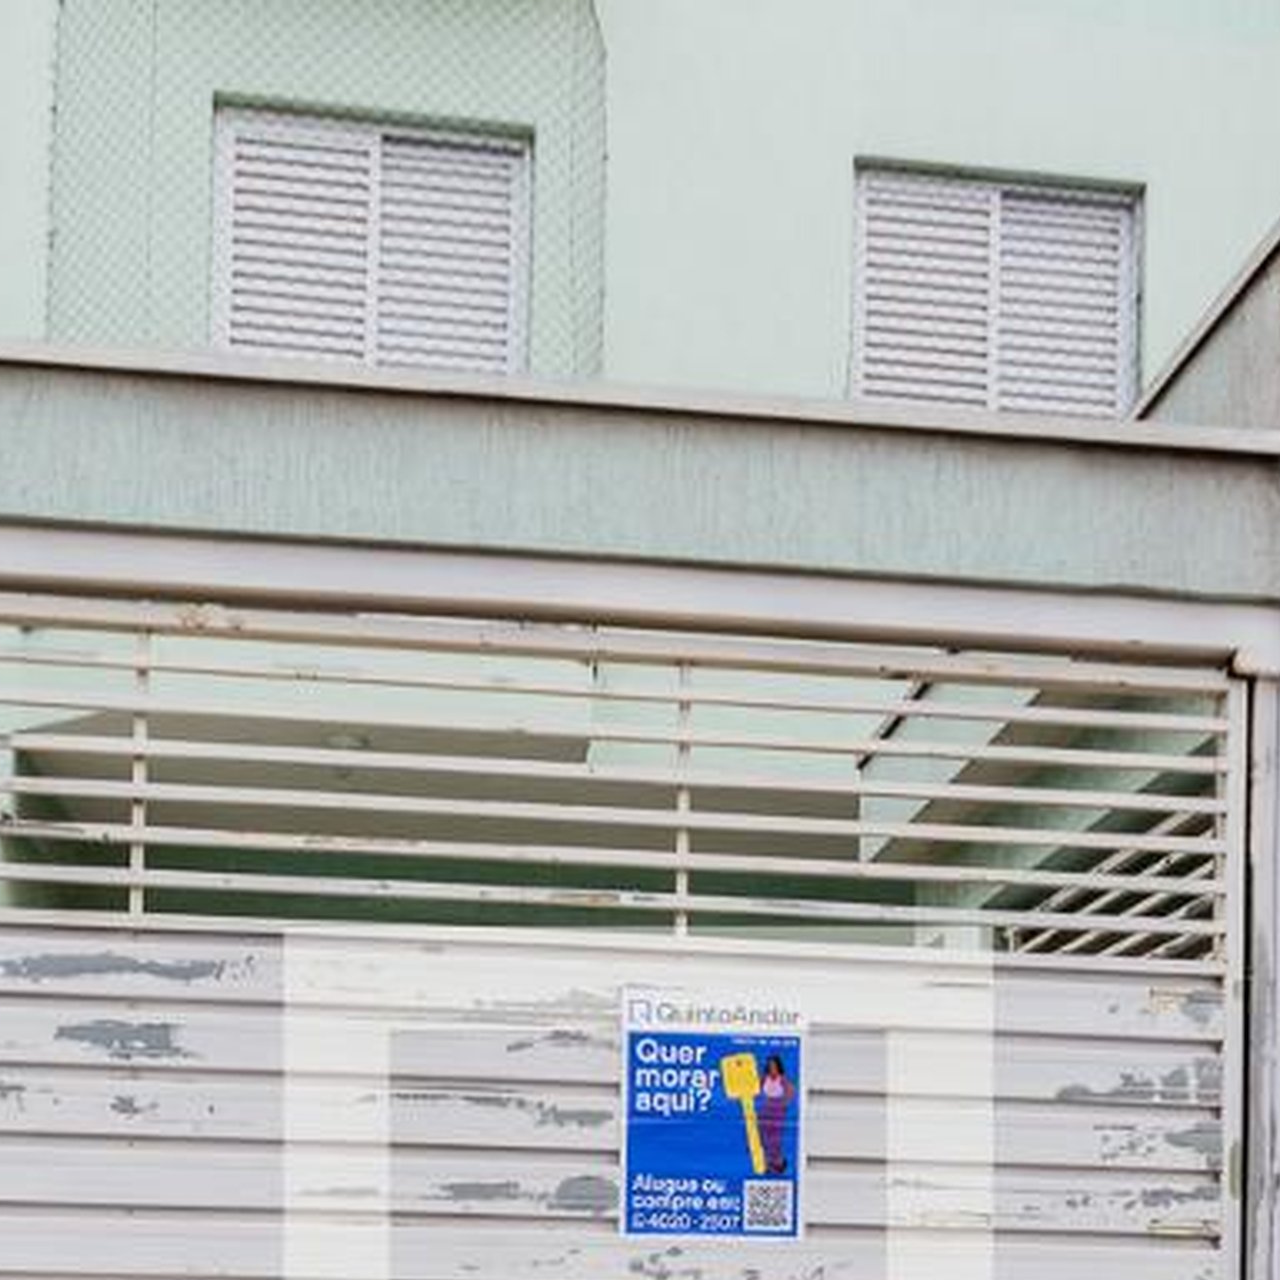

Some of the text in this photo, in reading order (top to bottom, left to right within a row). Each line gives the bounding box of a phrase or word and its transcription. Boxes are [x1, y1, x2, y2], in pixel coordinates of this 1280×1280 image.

[635, 1038, 708, 1063] Quer
[635, 1067, 719, 1089] morar
[635, 1089, 712, 1115] aqui?
[632, 1173, 698, 1195] Alugue
[632, 1195, 704, 1211] compre
